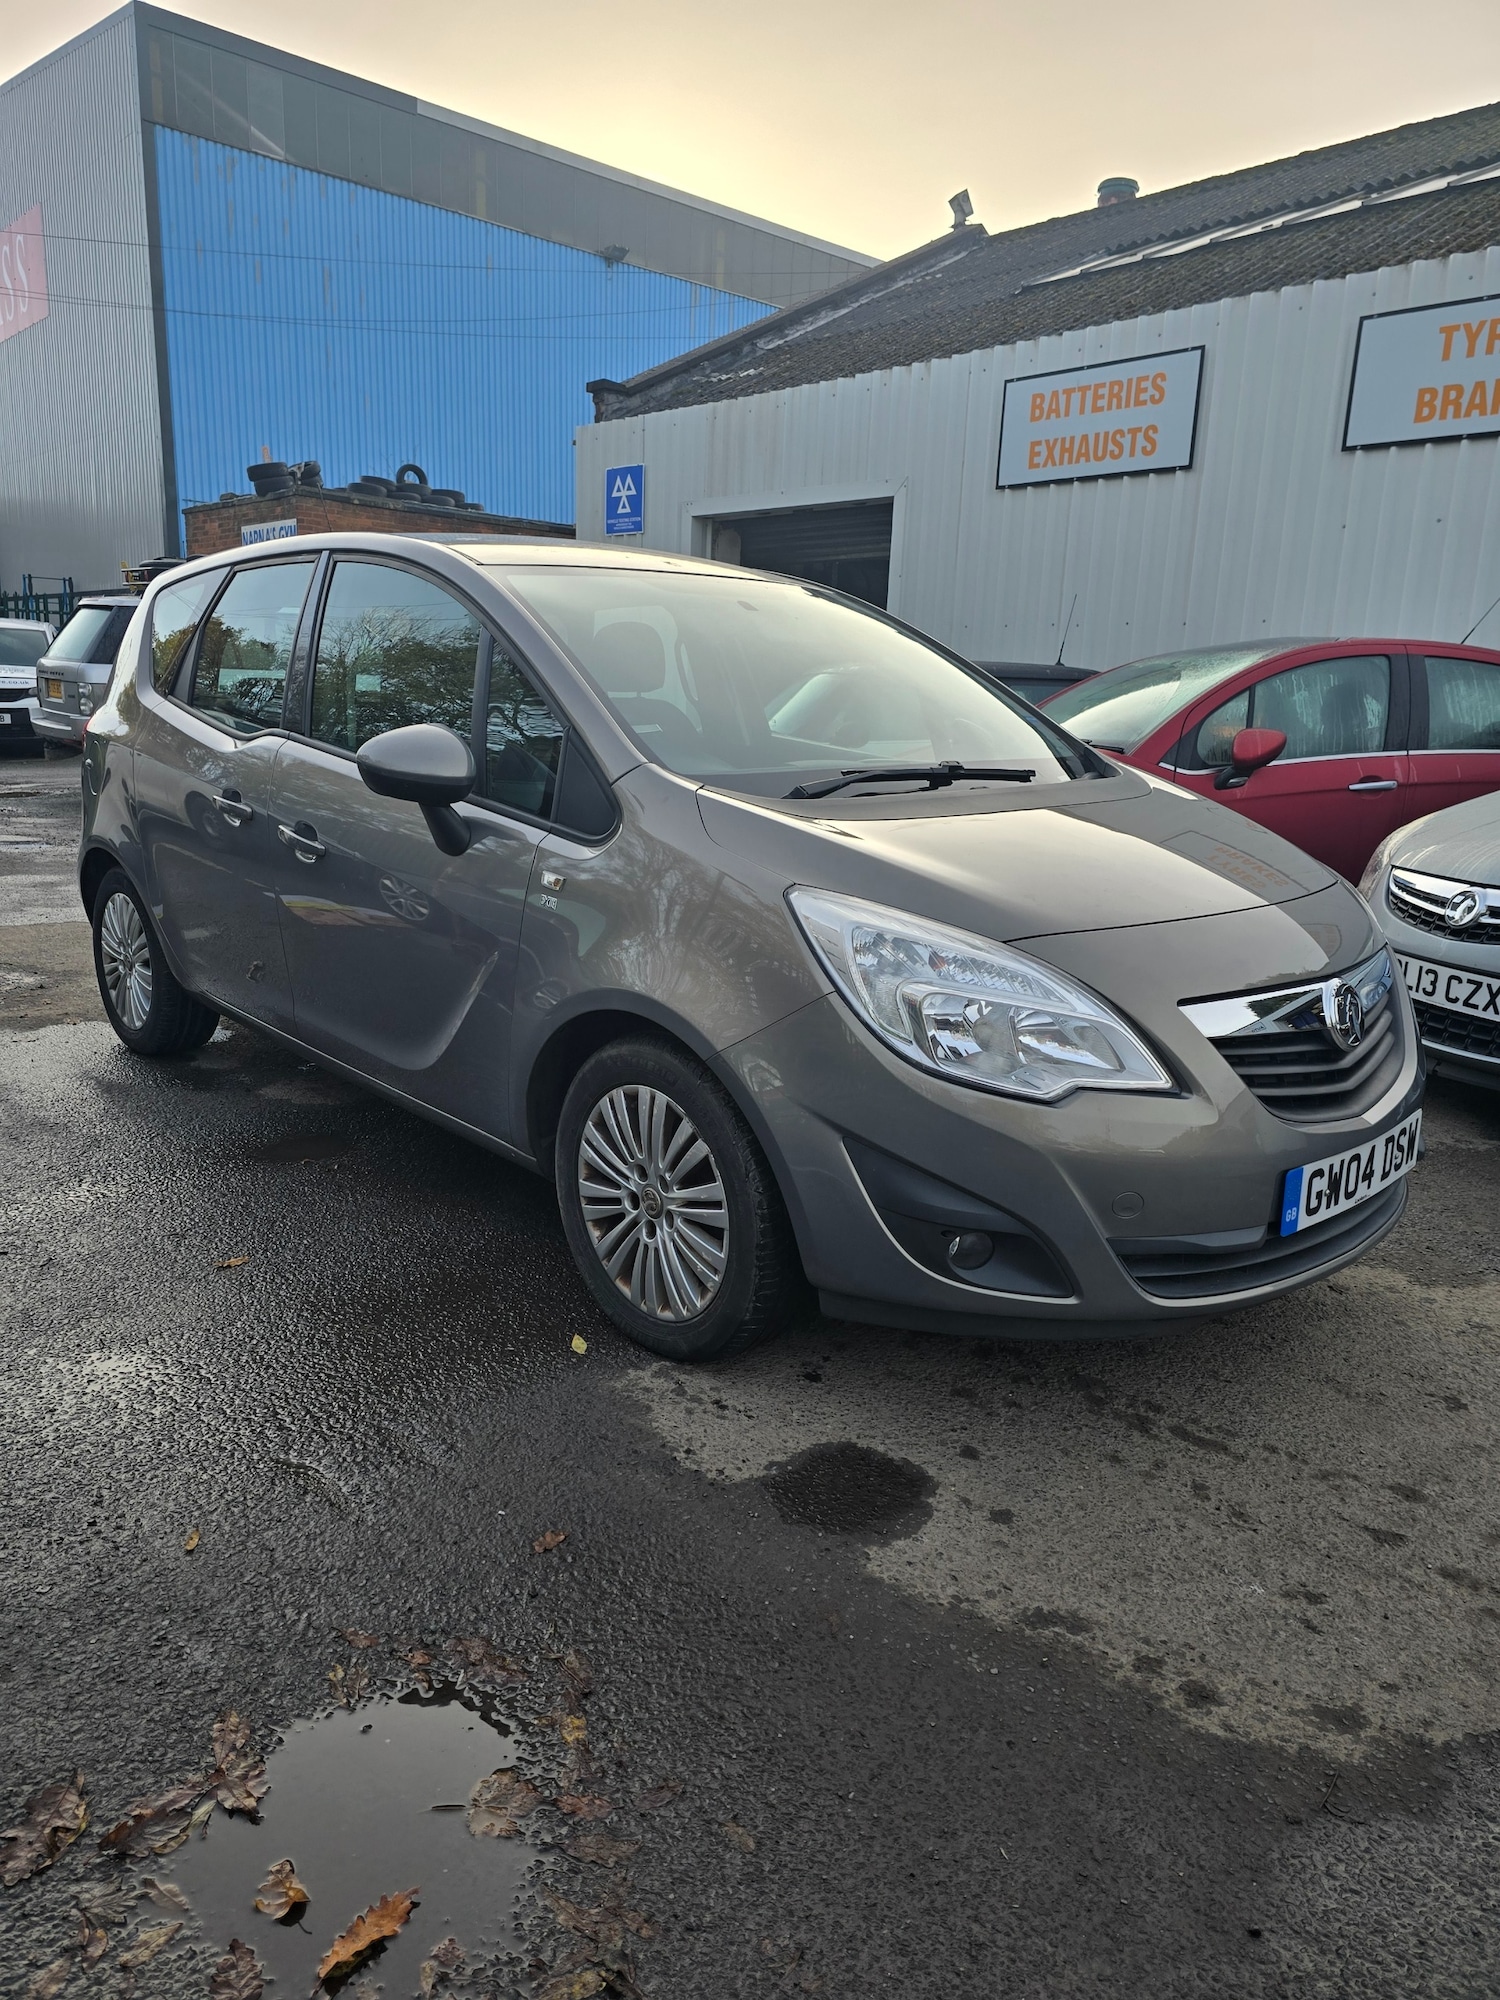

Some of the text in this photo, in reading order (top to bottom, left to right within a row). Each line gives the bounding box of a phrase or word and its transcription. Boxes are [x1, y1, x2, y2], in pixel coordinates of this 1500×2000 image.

[0, 234, 29, 325] SS
[1030, 372, 1167, 423] BATTERIES
[1028, 424, 1159, 470] EXHAUSTS
[1444, 974, 1500, 1016] CZX
[1305, 1118, 1419, 1217] GW04 DSW
[1286, 1207, 1297, 1222] GB
